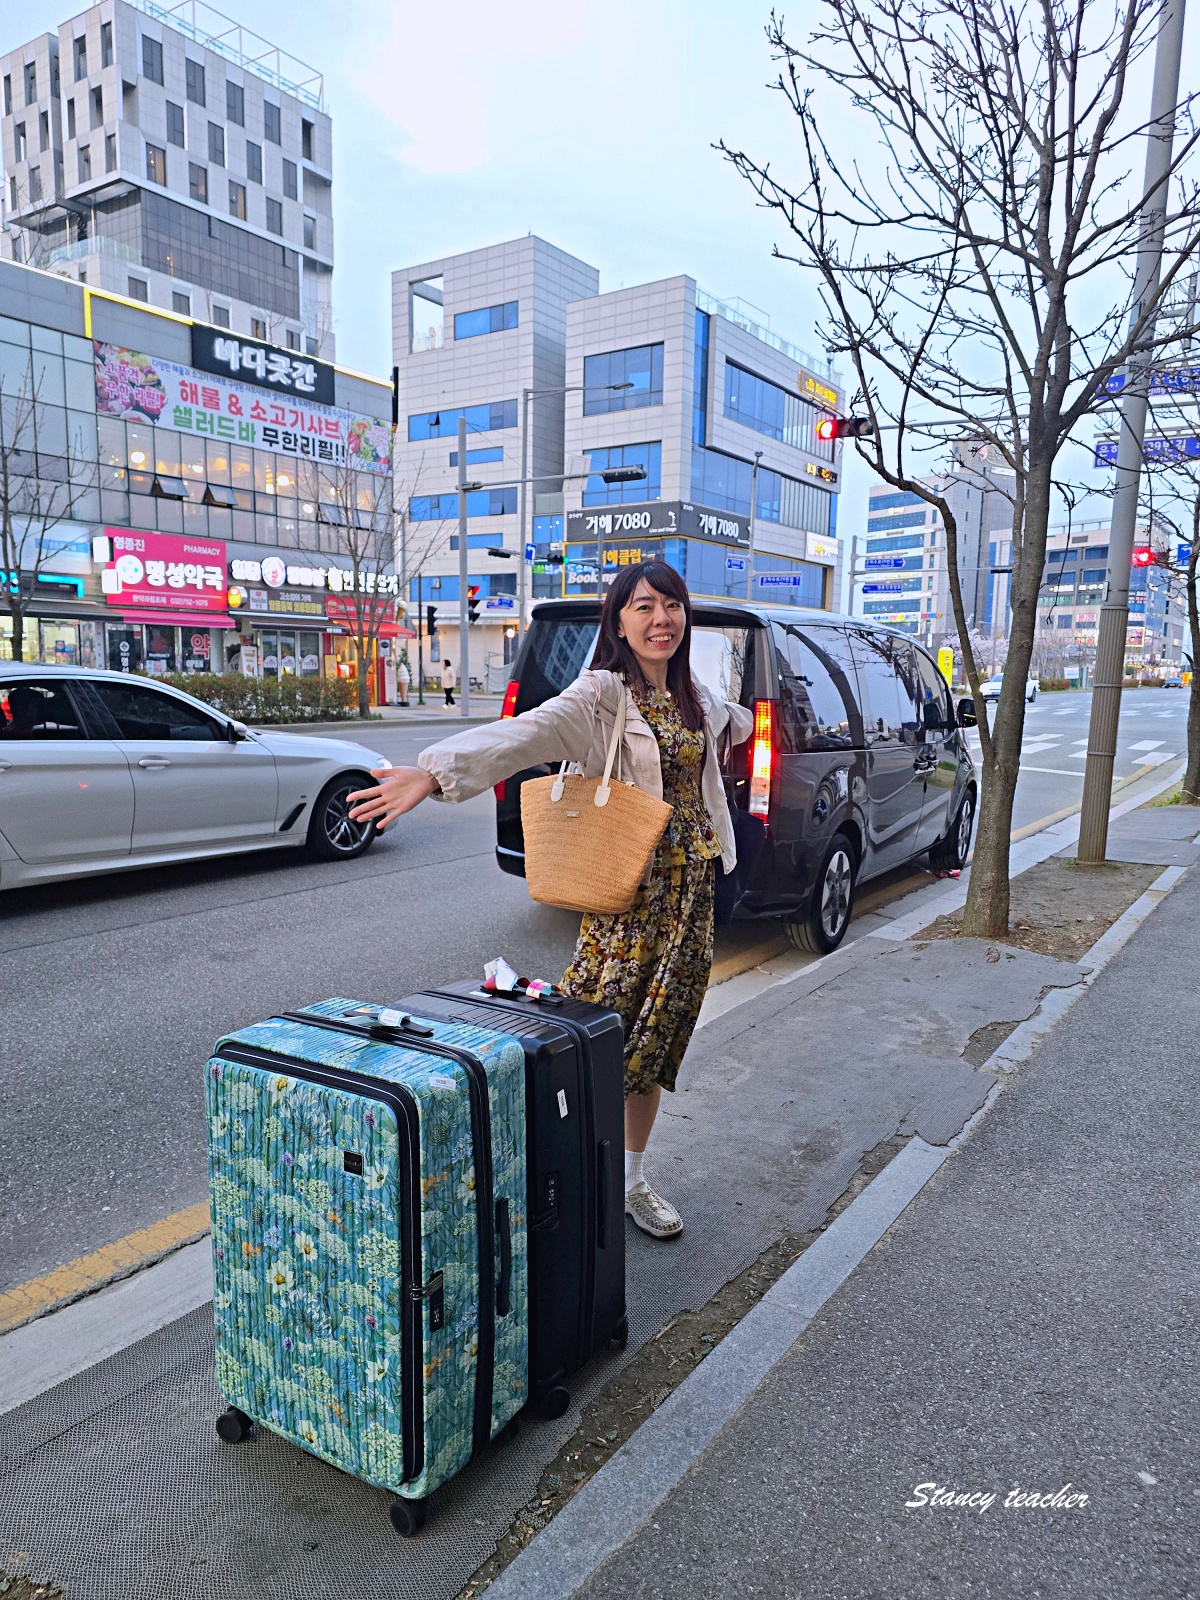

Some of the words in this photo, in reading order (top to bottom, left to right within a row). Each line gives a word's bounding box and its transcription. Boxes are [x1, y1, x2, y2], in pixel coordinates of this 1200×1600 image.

[105, 362, 140, 386] 고품격
[152, 359, 171, 373] 다양한
[172, 364, 190, 376] 해물과
[192, 370, 209, 382] 소고기
[214, 337, 317, 391] 바다곳간
[106, 381, 130, 403] 무한
[179, 379, 221, 411] 해물
[228, 393, 244, 417] &
[250, 400, 341, 440] 소고기샤브
[173, 404, 257, 444] 샐러드바
[614, 511, 651, 531] 7080
[717, 518, 739, 538] 7080
[113, 536, 145, 552] 영종진
[183, 544, 221, 556] PHARMACY
[601, 548, 641, 566] 해클럽
[145, 560, 224, 591] 명성약국
[568, 570, 619, 585] Bookng
